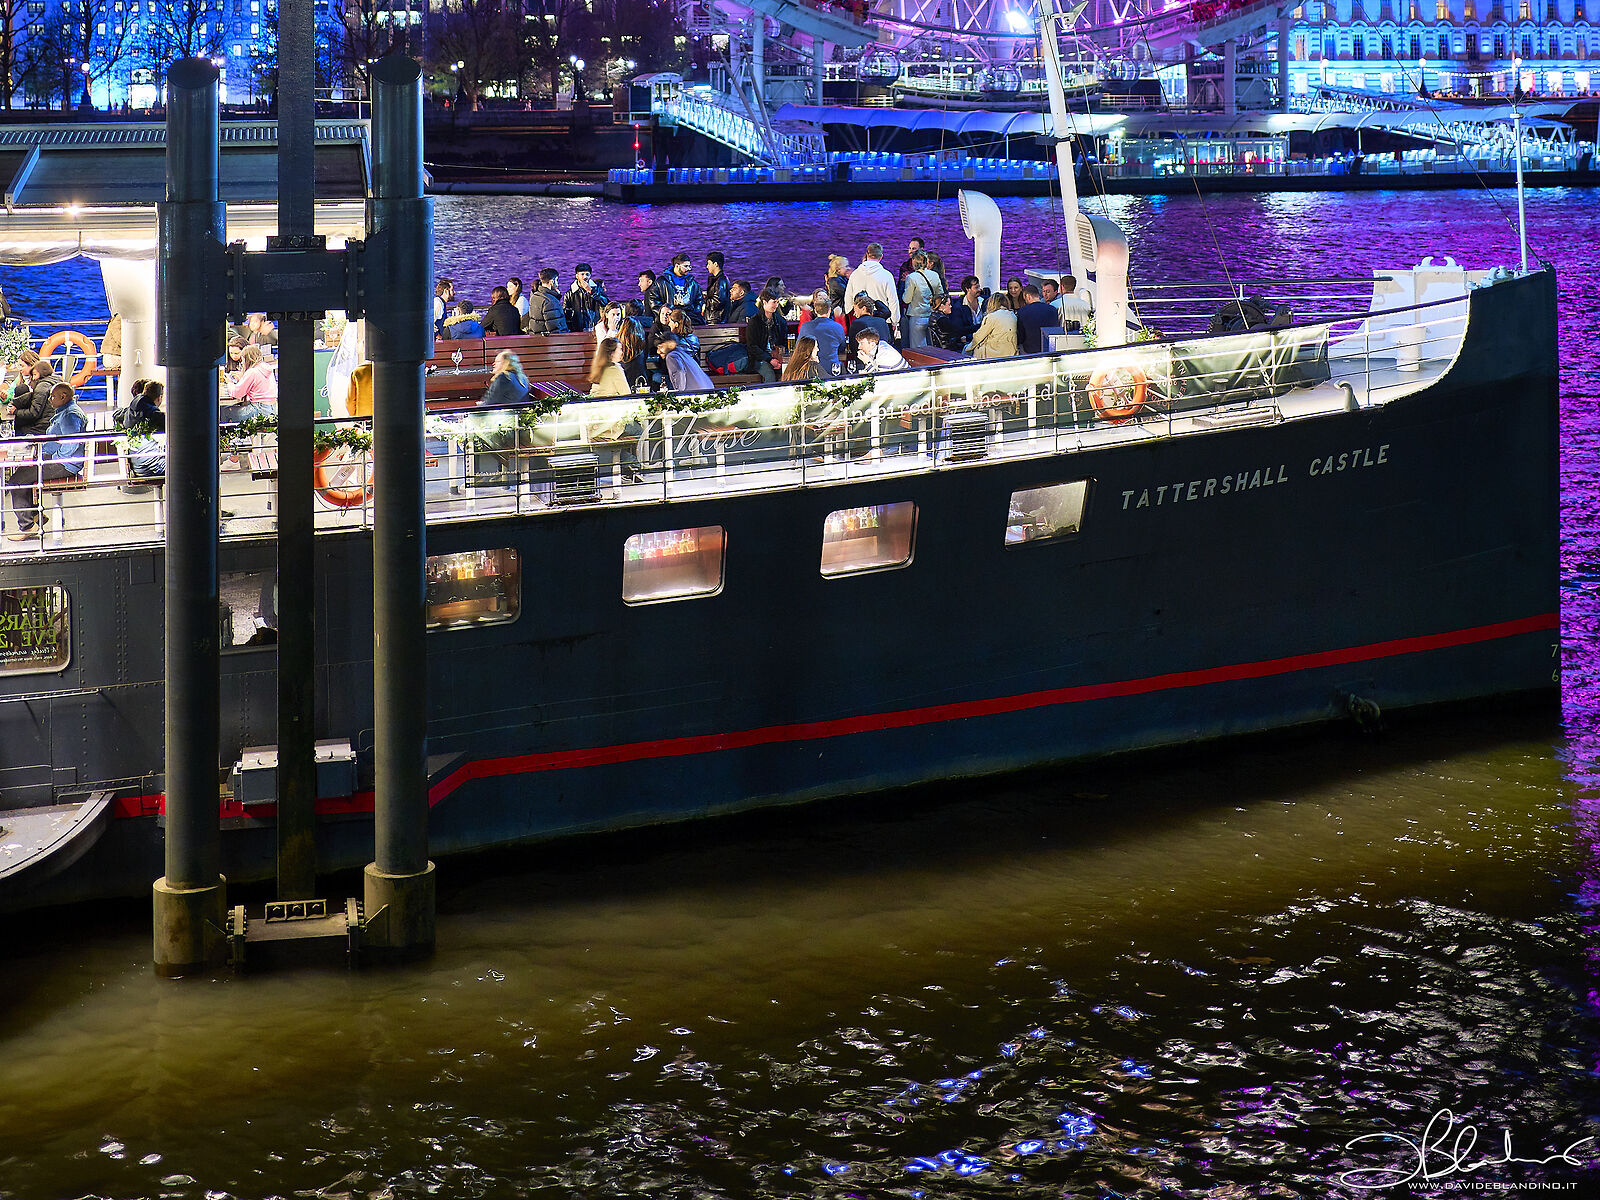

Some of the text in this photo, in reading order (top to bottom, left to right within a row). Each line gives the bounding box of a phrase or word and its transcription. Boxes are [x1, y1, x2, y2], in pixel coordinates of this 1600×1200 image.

[1006, 383, 1052, 405] wid
[637, 411, 762, 467] Chase
[1121, 444, 1390, 510] TATTERSHALL CASTLE
[1551, 644, 1559, 658] 7
[1551, 669, 1559, 682] 6
